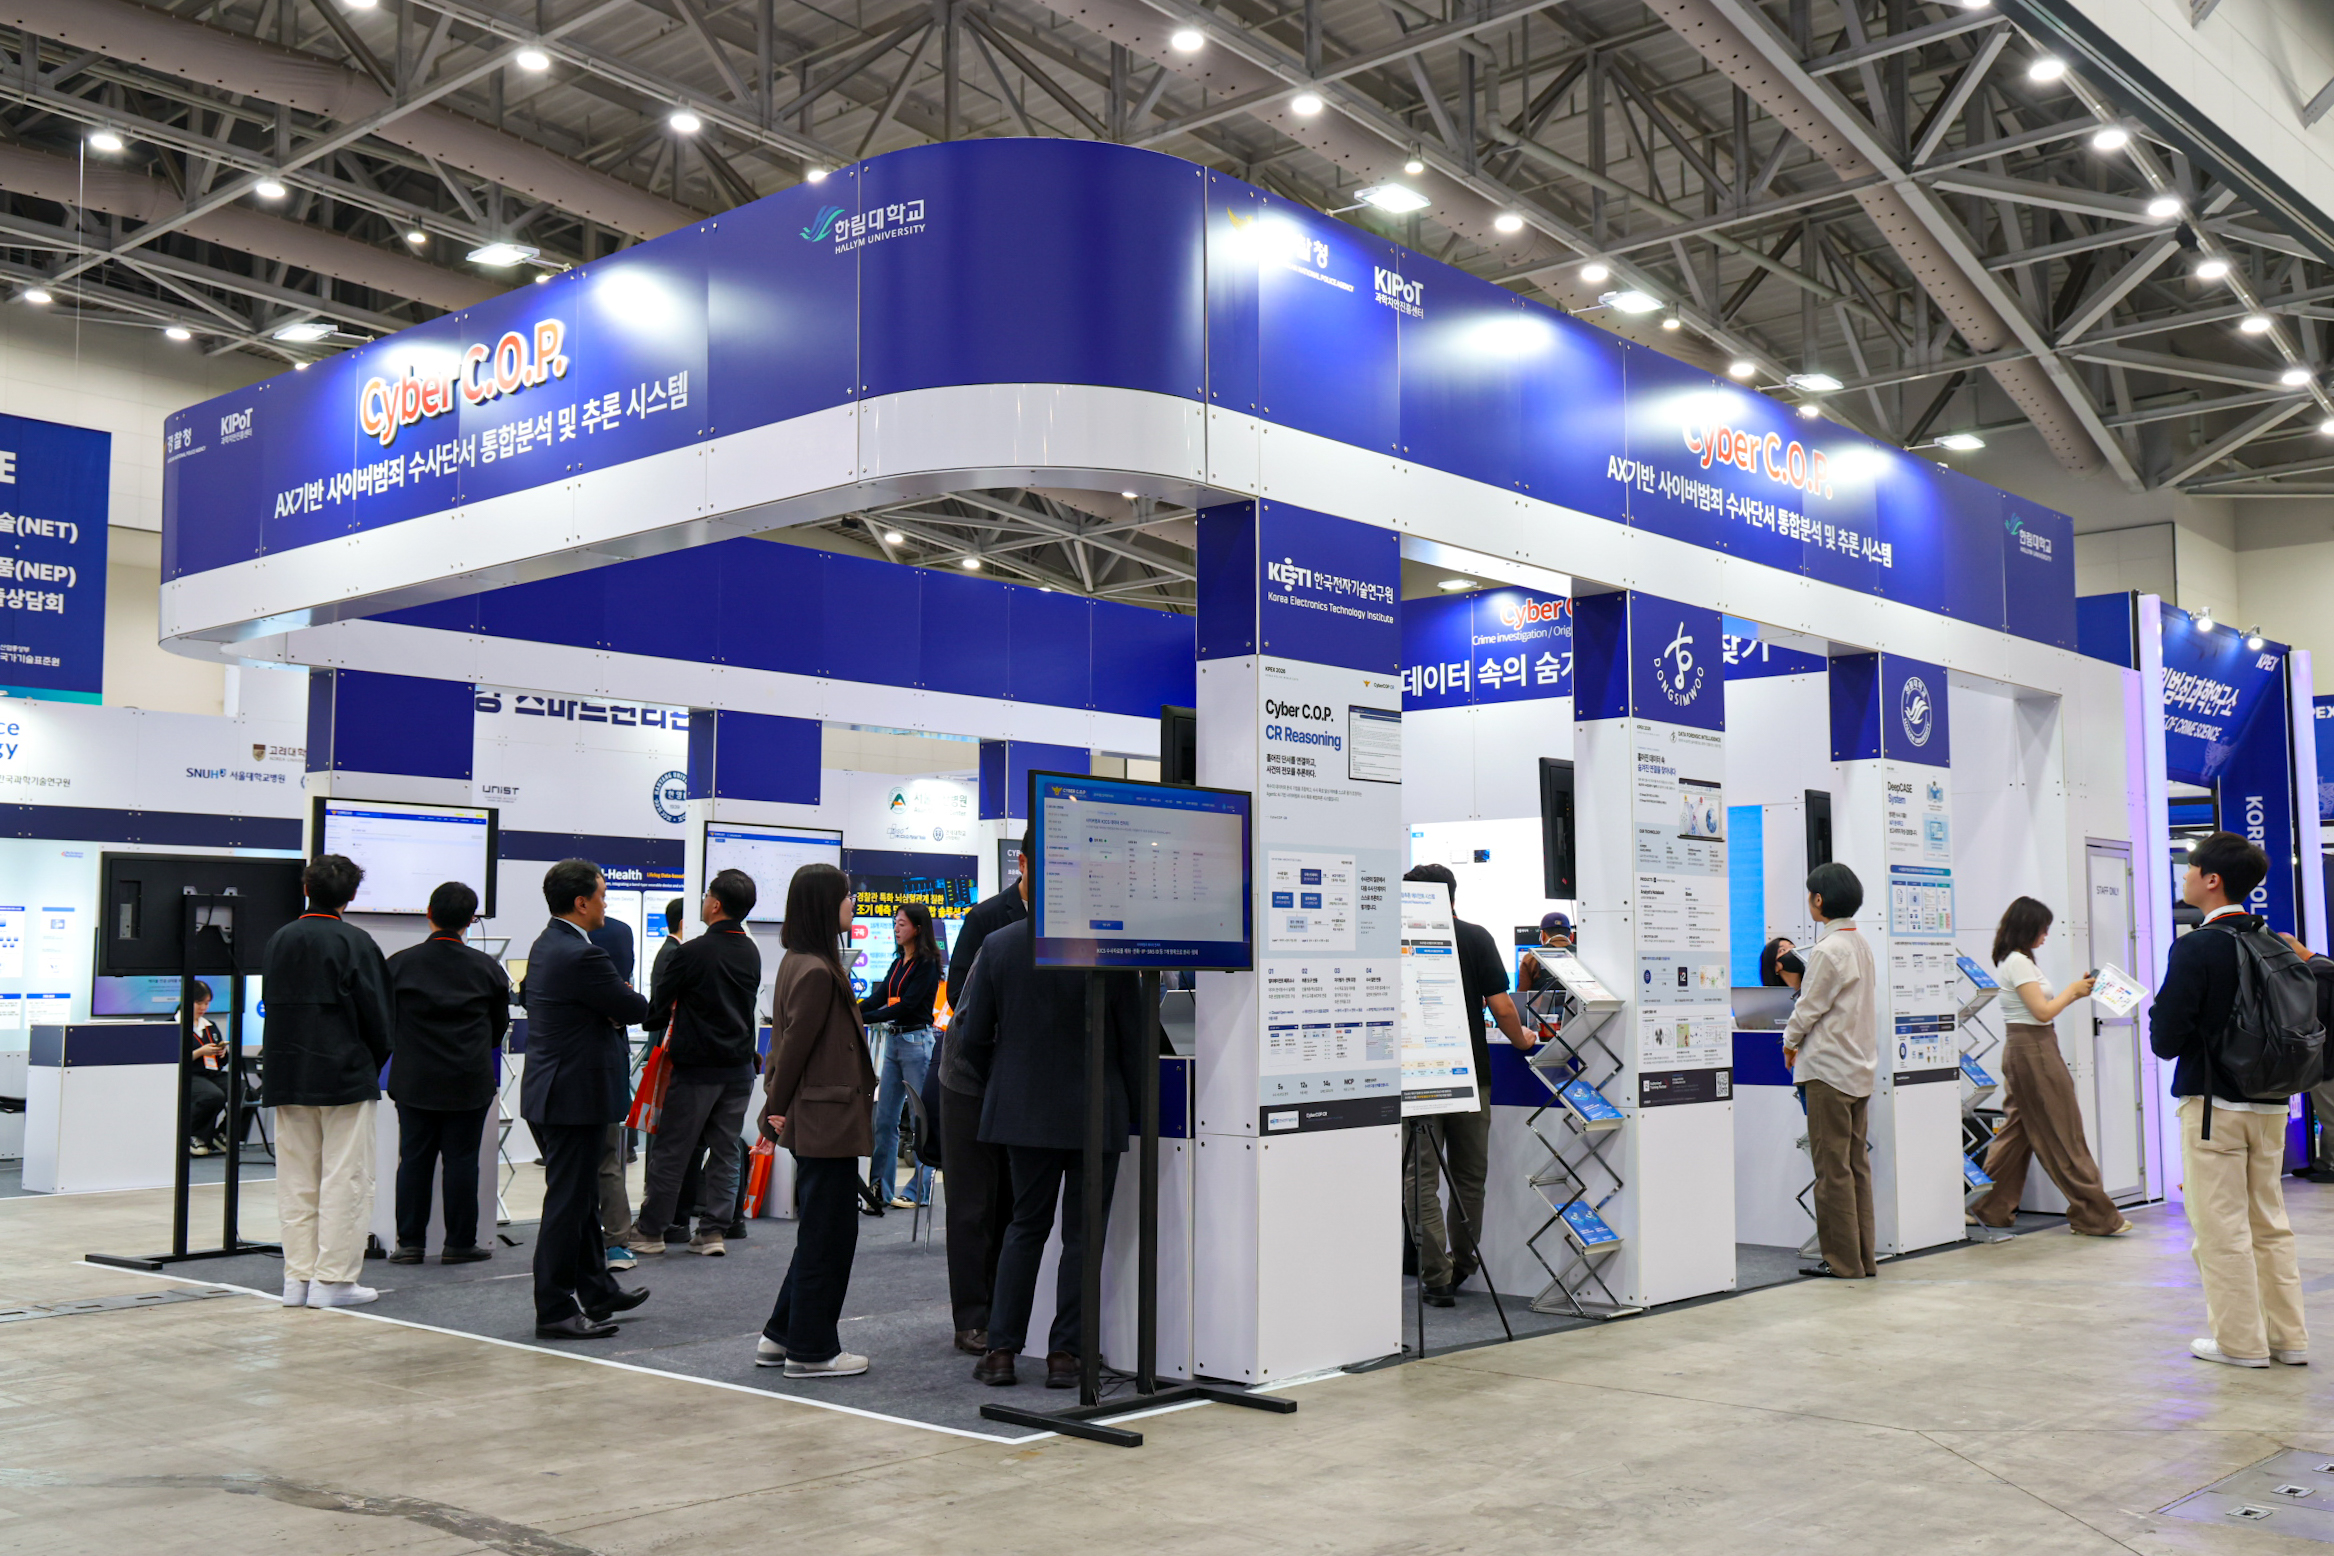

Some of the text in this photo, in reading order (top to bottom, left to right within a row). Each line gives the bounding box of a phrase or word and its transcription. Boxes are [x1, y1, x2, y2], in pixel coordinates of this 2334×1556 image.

[835, 199, 925, 243] 한림대학교
[835, 224, 926, 255] HALLYM UNIVERSITY
[1294, 234, 1329, 268] 찰청
[1374, 266, 1424, 306] KIPoT
[1375, 292, 1424, 319] 과학치안진흥센터
[359, 318, 570, 446] Cyber C.O.P.
[221, 407, 253, 437] KIPoT
[167, 427, 192, 454] 경찰청
[274, 370, 689, 519] AX기반 사이버범죄 수사단서 통합분석 및 추론 시스템
[1682, 420, 1834, 500] Cyber C.O.P.
[1606, 455, 1893, 568] AX기반 사이버범죄 수사단서 통합분석 및 추론 시스템
[0, 511, 79, 545] 술(NET)
[2019, 529, 2052, 554] 한림대학교
[0, 557, 77, 588] 품(NEP)
[1268, 557, 1312, 592] KETI
[0, 588, 65, 615] 상담회
[1314, 571, 1394, 605] 한국전자기술연구원
[1267, 591, 1394, 624] Korea Electronics Technology Institute
[1500, 598, 1564, 631] Cyber
[1472, 634, 1497, 646] Crime
[1497, 628, 1547, 643] investigation
[0, 652, 61, 667] 국가기술표준원
[2256, 652, 2280, 672] KPEX
[1401, 659, 1470, 696] 데이터
[1477, 654, 1527, 689] 속의
[1653, 657, 1704, 707] DONGSIMWOO
[1265, 699, 1334, 722] Cyber C.O.P.
[1266, 724, 1342, 751] CR Reasoning
[2166, 716, 2179, 731] OF
[2174, 718, 2198, 738] CRIME
[2194, 721, 2222, 742] SCIENCE
[186, 767, 220, 779] SNUH
[1266, 765, 1317, 778] 사건의 전모를 추론하다.
[1281, 755, 1295, 765] 단서를
[1296, 757, 1317, 767] 연결하고,
[230, 770, 286, 784] 서울대학교병원
[1887, 781, 1913, 794] DeepCASE
[1888, 793, 1906, 805] System
[2245, 795, 2266, 851] KORE
[856, 892, 878, 903] 경찰관
[856, 904, 874, 916] 조기
[875, 904, 892, 916] 예측
[2250, 874, 2269, 920] OL
